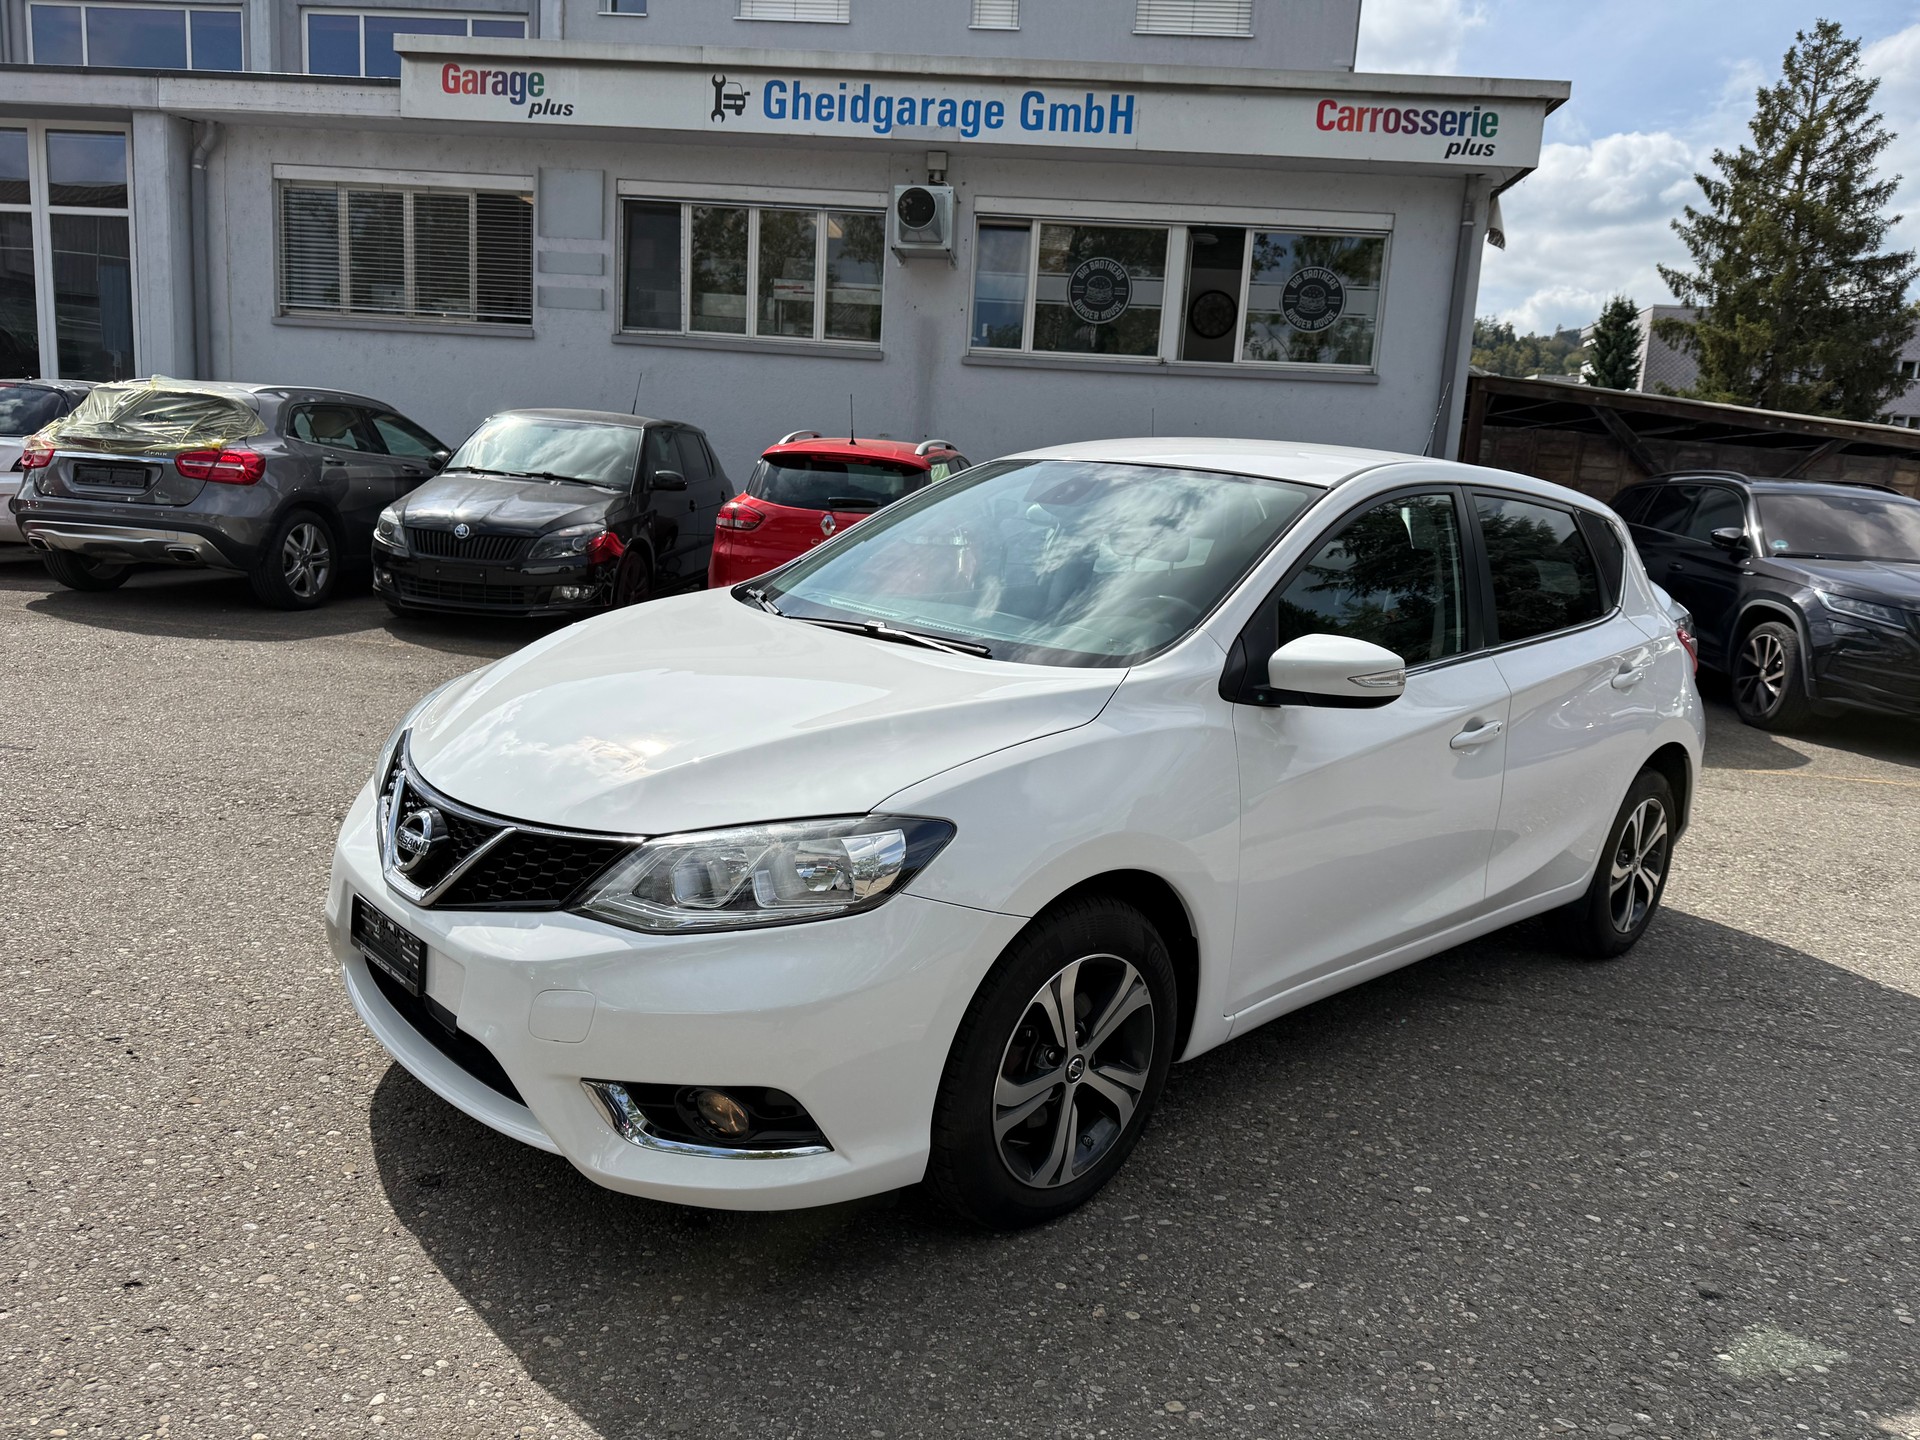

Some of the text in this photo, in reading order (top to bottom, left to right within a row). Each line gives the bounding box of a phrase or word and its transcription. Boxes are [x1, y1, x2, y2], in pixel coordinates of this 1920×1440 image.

[441, 62, 545, 106] Garage
[528, 98, 575, 119] plus
[762, 79, 1136, 138] Gheidgarage GmbH
[1316, 99, 1499, 138] Carrosserie
[1444, 138, 1496, 159] plus
[1076, 260, 1126, 281] BIG BROTHERS
[1289, 269, 1339, 290] BIG BROTHERS
[1073, 298, 1124, 320] BURGER HOUSE
[1285, 308, 1337, 329] BURGER HOUSE
